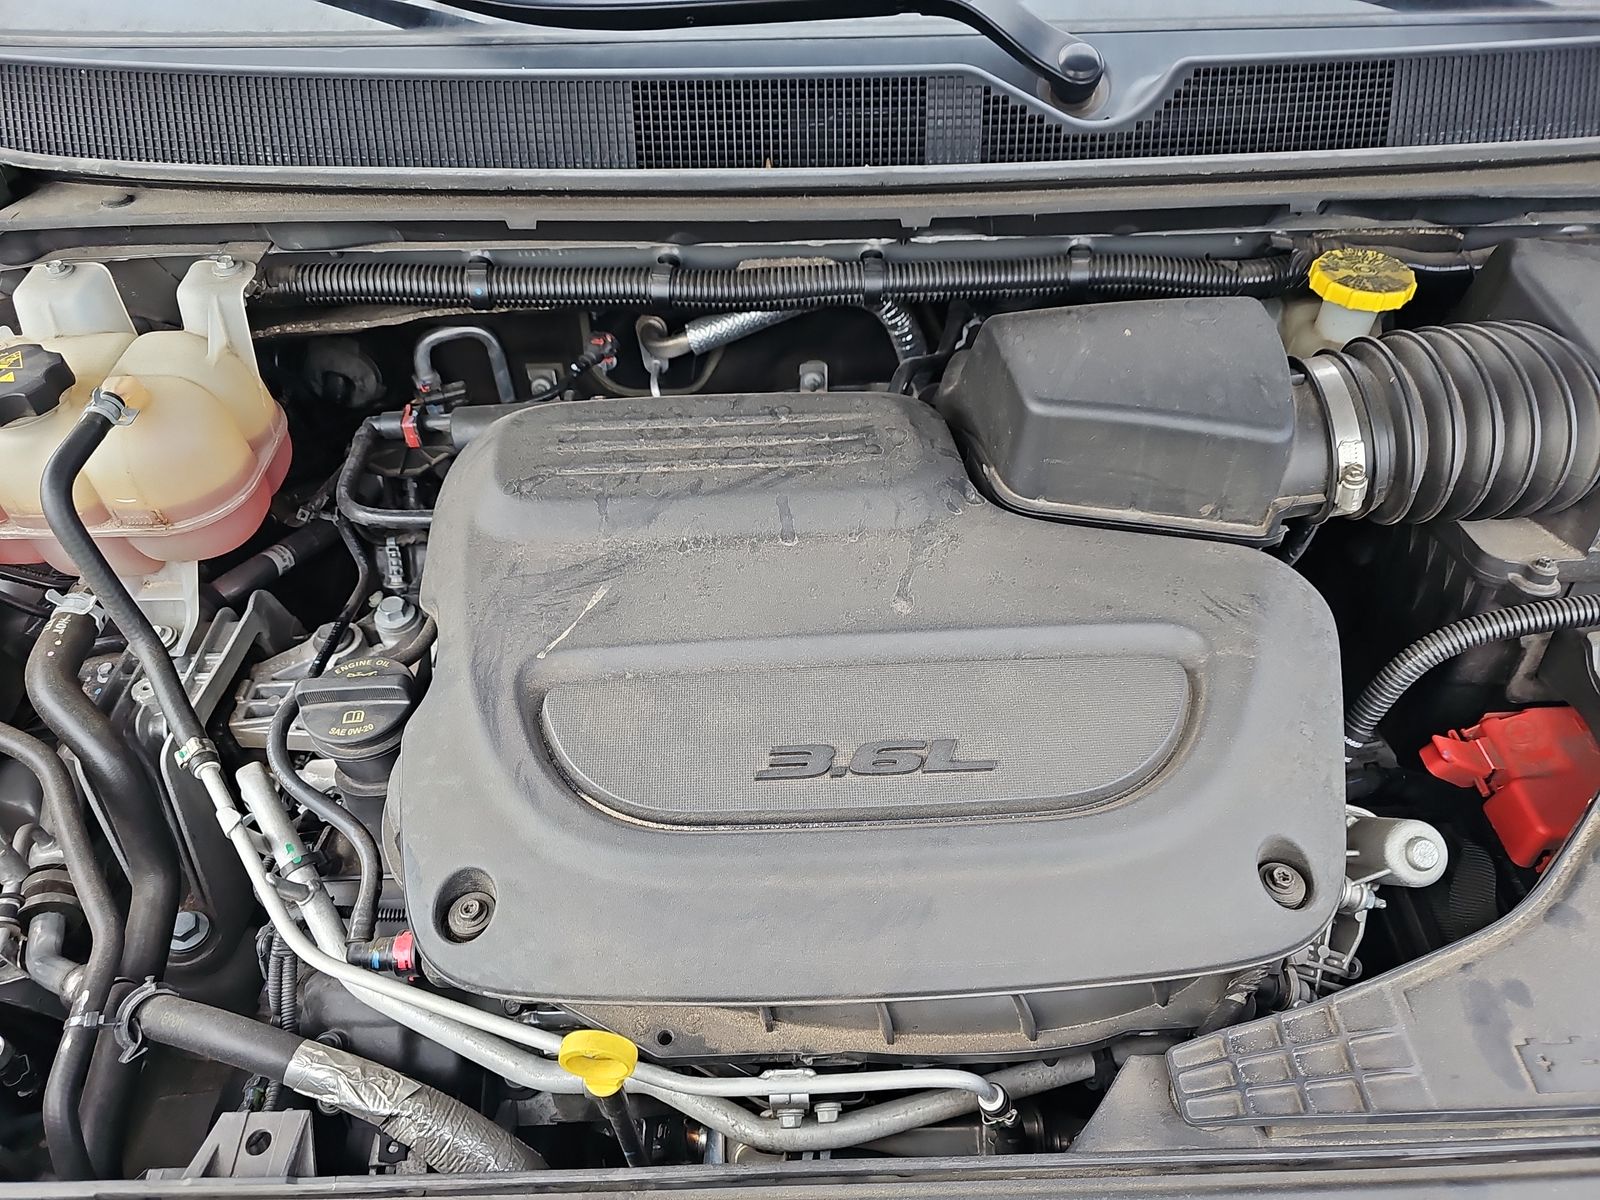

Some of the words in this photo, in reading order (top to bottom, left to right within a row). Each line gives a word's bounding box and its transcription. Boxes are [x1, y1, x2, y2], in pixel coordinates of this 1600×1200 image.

[335, 660, 372, 675] ENGINE
[375, 659, 391, 668] OIL
[328, 727, 347, 736] SAE
[347, 723, 375, 736] 0W-20
[754, 739, 998, 781] 3.6L
